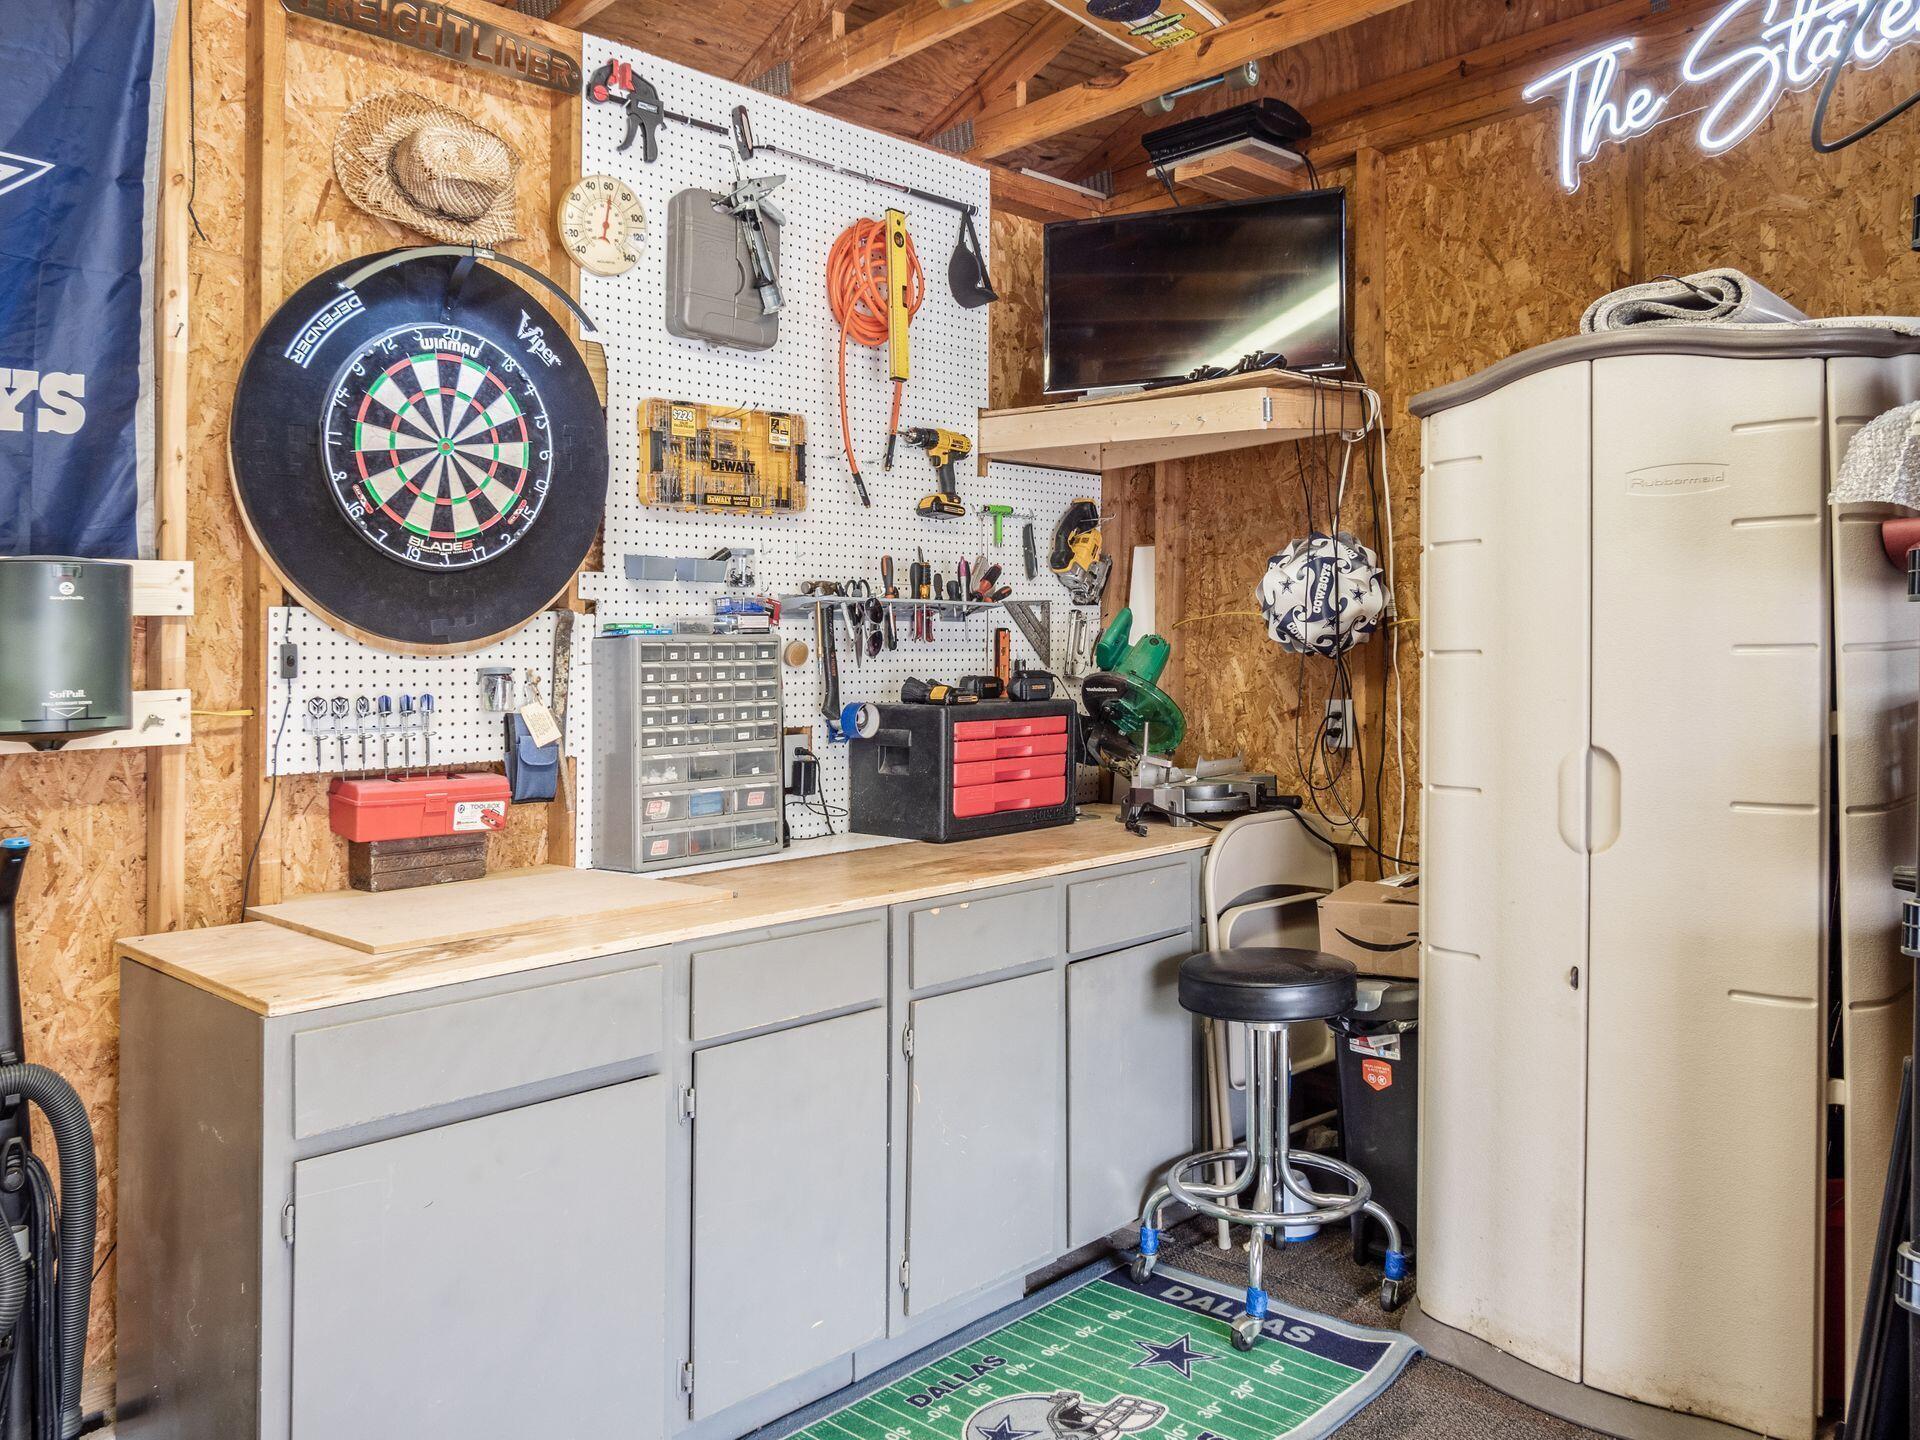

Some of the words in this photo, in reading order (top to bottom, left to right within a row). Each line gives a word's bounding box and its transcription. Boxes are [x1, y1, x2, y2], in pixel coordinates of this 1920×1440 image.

[301, 0, 571, 87] REIGHTLINER
[1523, 39, 1667, 191] The
[570, 193, 580, 201] 20
[586, 181, 595, 190] 40
[604, 182, 613, 191] 60
[621, 193, 631, 201] 80
[290, 295, 363, 363] DEFENDER
[517, 309, 562, 367] Viper
[711, 460, 755, 473] DEWALT
[408, 536, 473, 551] BLADE6
[1313, 563, 1332, 613] COWBOYS
[1160, 1286, 1315, 1343] DALAS
[905, 1355, 1008, 1409] DALLAS
